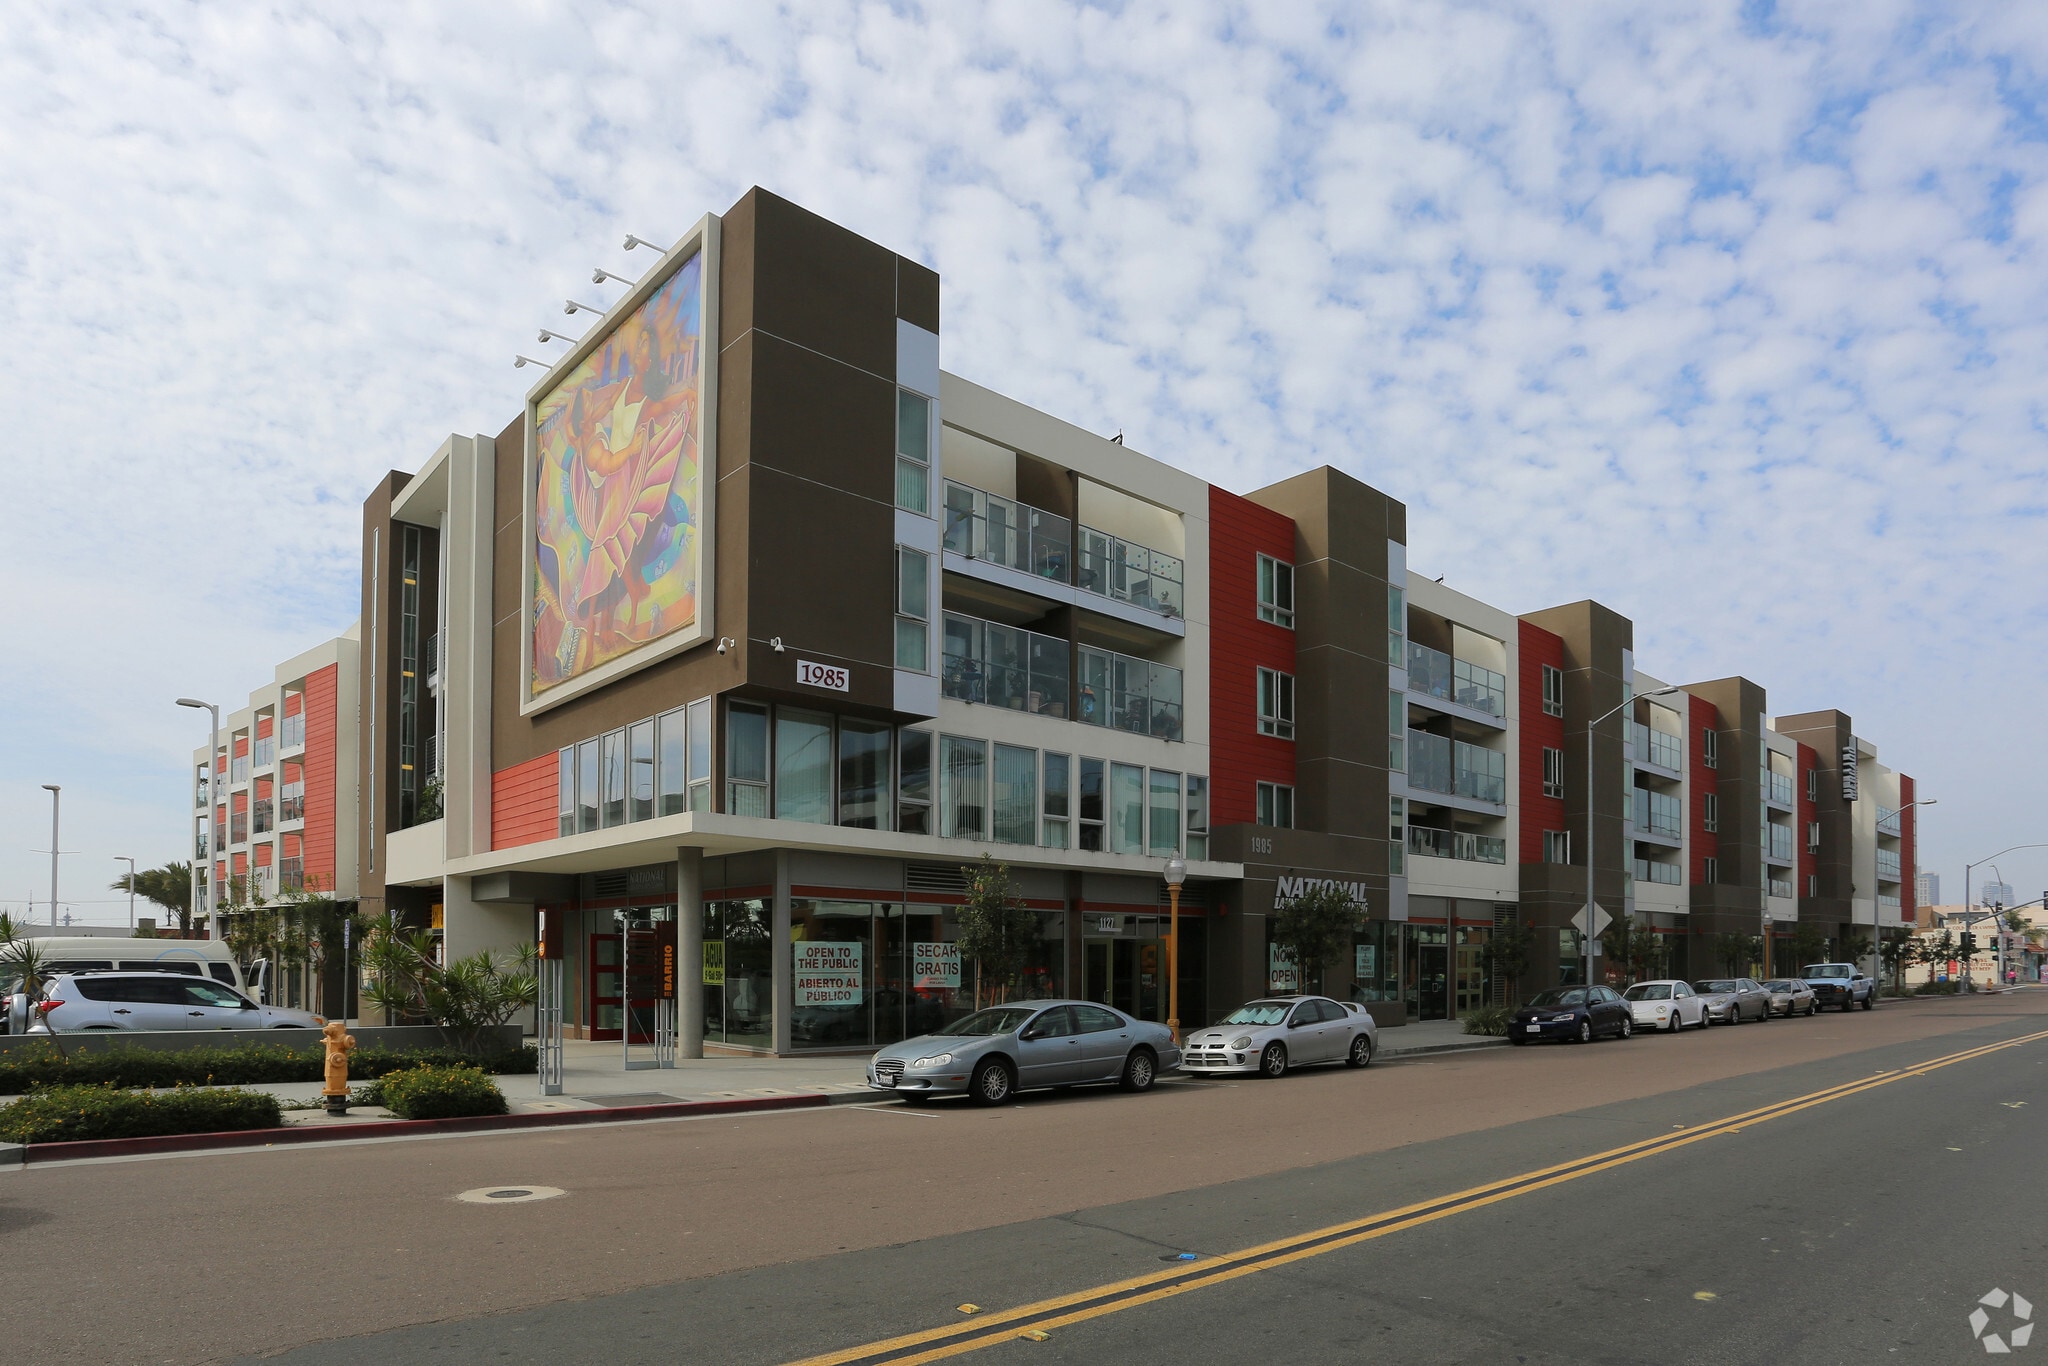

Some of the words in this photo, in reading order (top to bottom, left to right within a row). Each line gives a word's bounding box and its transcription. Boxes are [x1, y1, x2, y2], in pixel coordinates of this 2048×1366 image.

[802, 664, 845, 688] 1985
[1251, 836, 1272, 854] 1985
[630, 869, 665, 883] NATIONAL
[1100, 917, 1114, 928] 1127
[705, 943, 723, 968] AGUA
[806, 947, 834, 958] OPEN
[837, 947, 851, 957] TO
[916, 944, 958, 958] SECAR
[664, 944, 673, 991] BARRIO
[798, 958, 819, 968] THE
[822, 958, 859, 969] PUBLIC
[915, 962, 959, 975] GRATIS
[1271, 969, 1297, 982] OPEN
[798, 978, 843, 989] ABIERTO
[846, 978, 859, 988] AL
